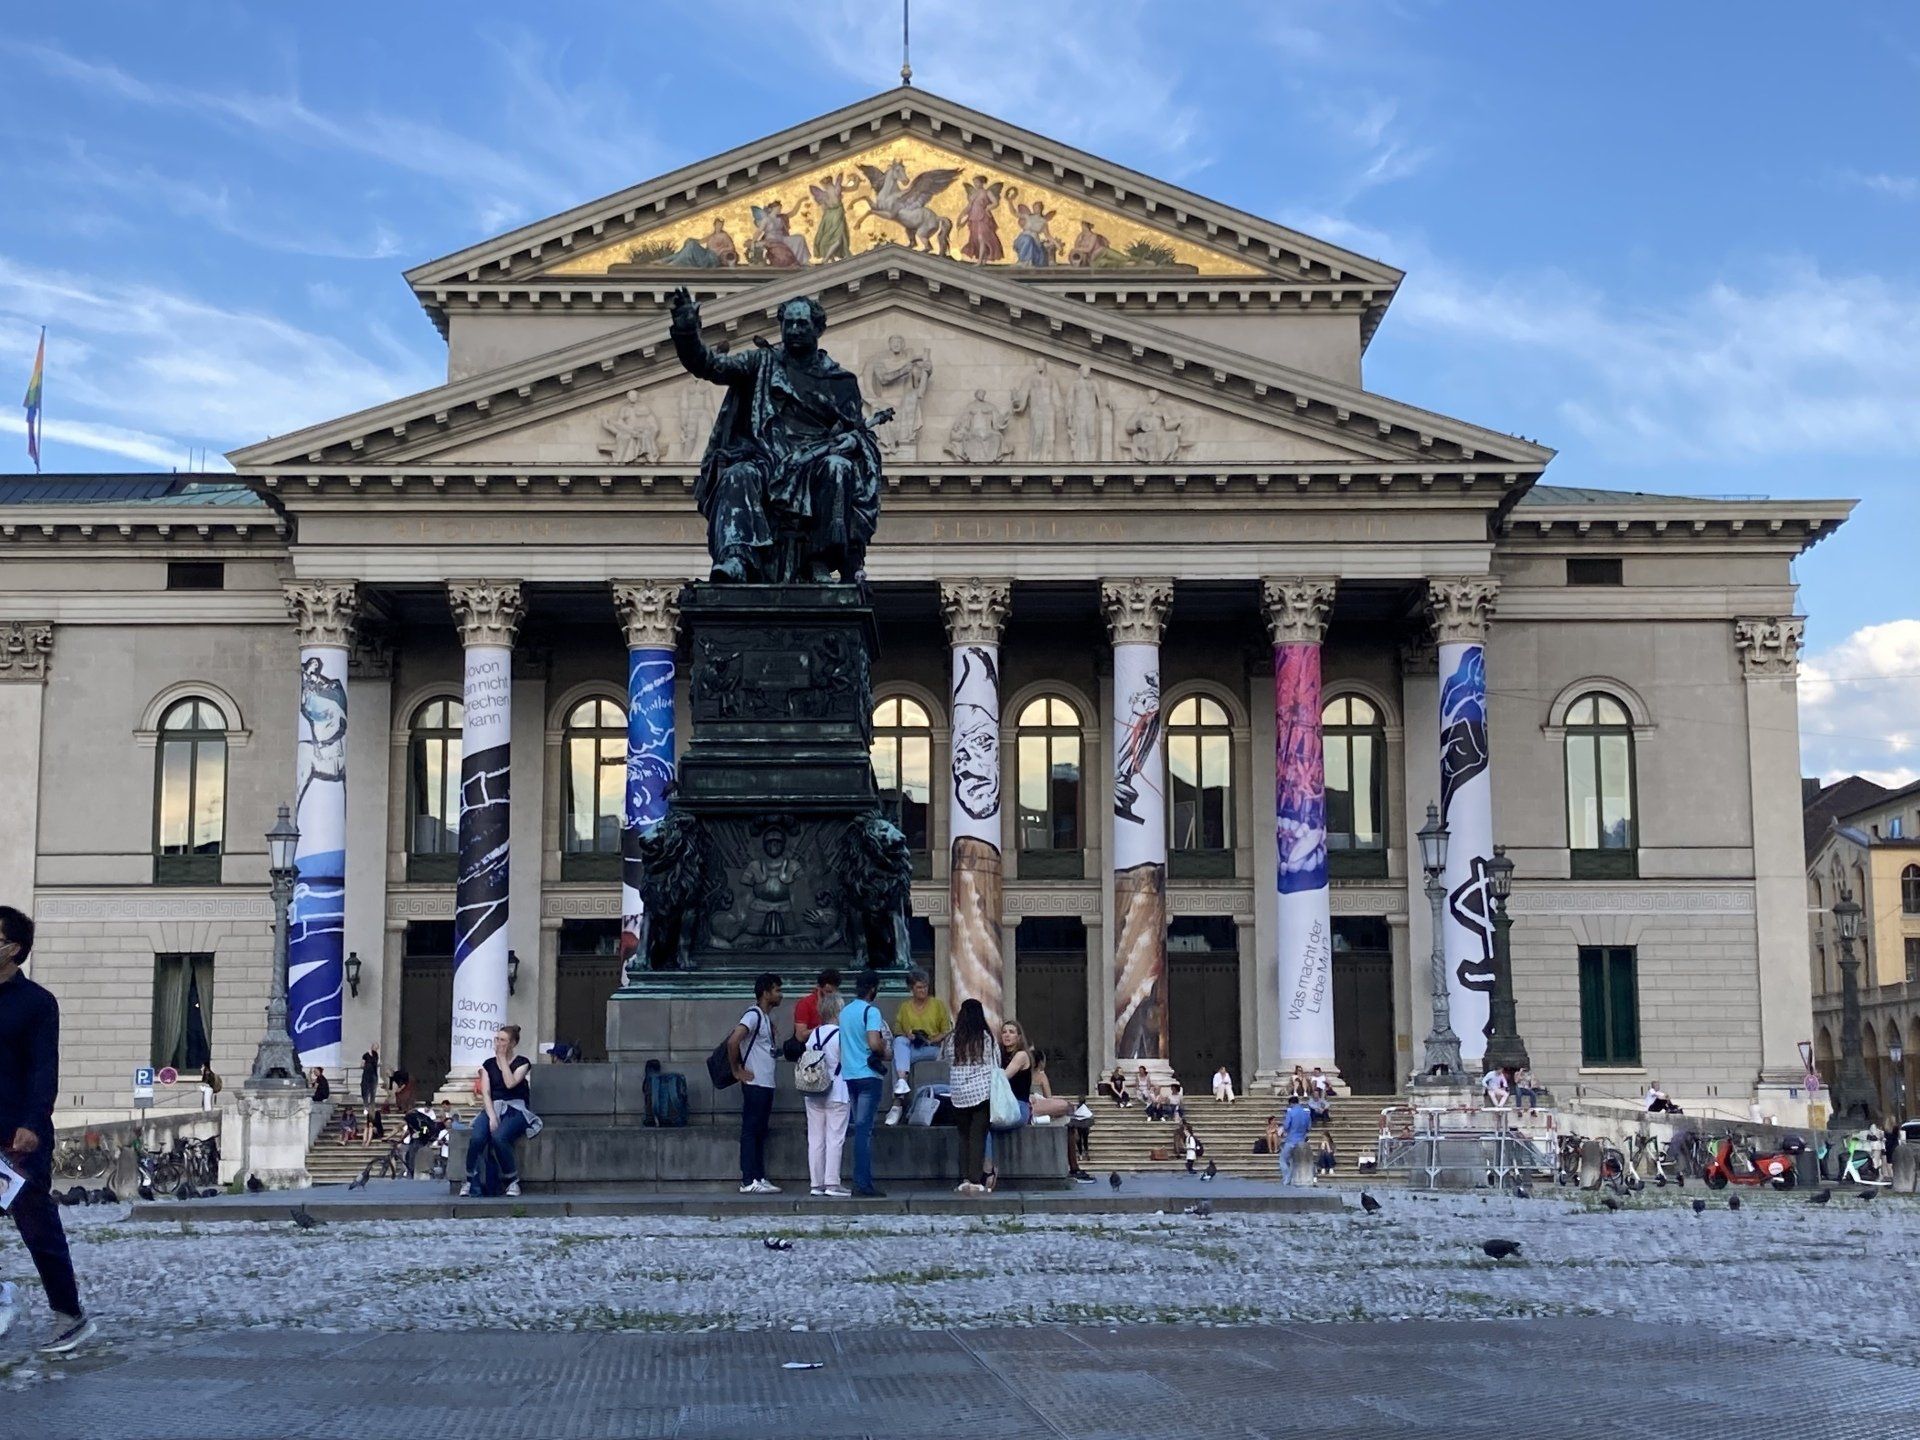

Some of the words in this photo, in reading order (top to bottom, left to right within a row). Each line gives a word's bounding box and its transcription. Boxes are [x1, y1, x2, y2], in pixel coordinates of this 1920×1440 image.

[466, 661, 500, 678] ovon
[469, 713, 501, 728] kann
[1288, 990, 1307, 1020] Was
[1299, 945, 1317, 989] macht
[1309, 919, 1322, 944] der
[1307, 975, 1326, 1014] Liebe
[458, 997, 498, 1014] davon
